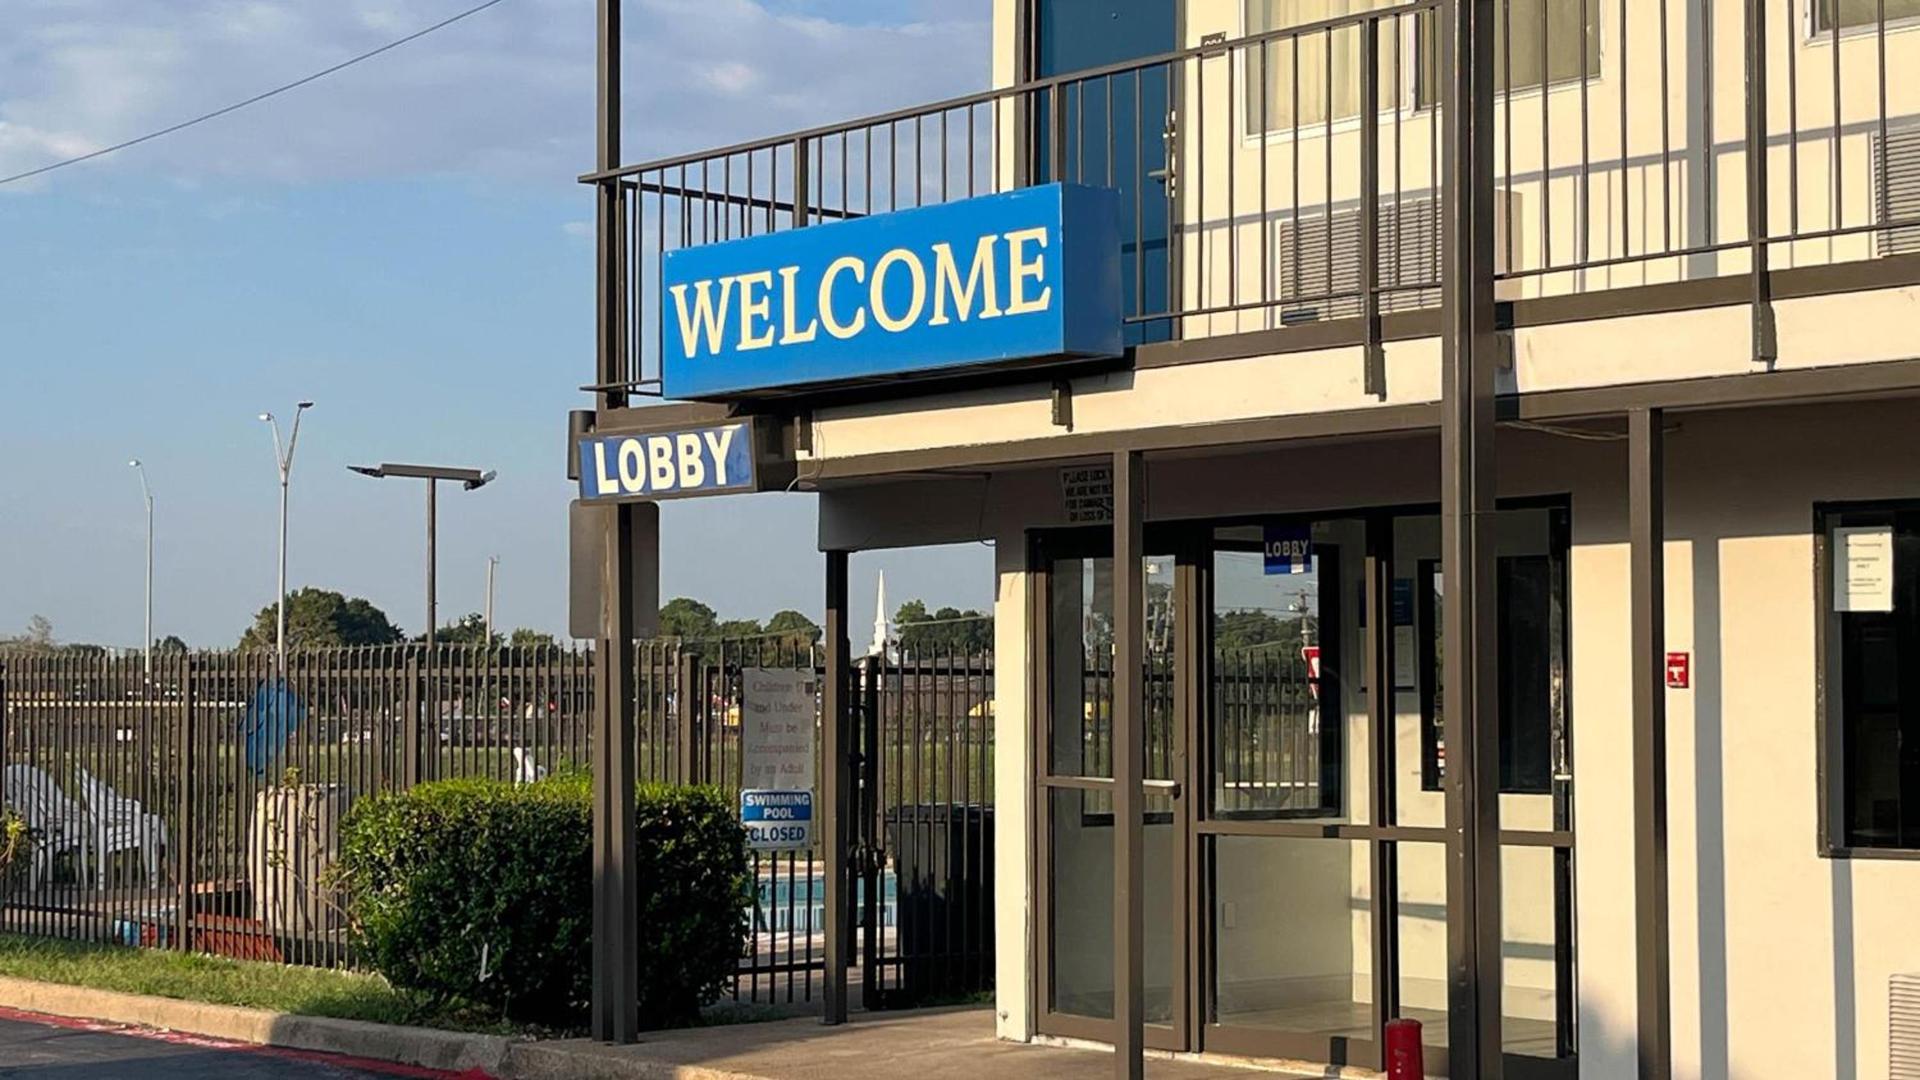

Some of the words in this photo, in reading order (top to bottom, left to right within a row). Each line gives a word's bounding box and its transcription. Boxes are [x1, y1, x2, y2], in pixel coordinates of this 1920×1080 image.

[668, 226, 1052, 359] WELCOME
[594, 430, 734, 494] LOBBY
[1063, 470, 1088, 484] PLEASE
[1265, 539, 1310, 558] LOBBY
[752, 680, 792, 692] Children
[774, 701, 803, 713] Under
[786, 722, 799, 734] be
[750, 765, 762, 776] by
[745, 794, 810, 807] SWIMMING
[763, 807, 795, 819] POOL
[750, 826, 805, 842] CLOSED
